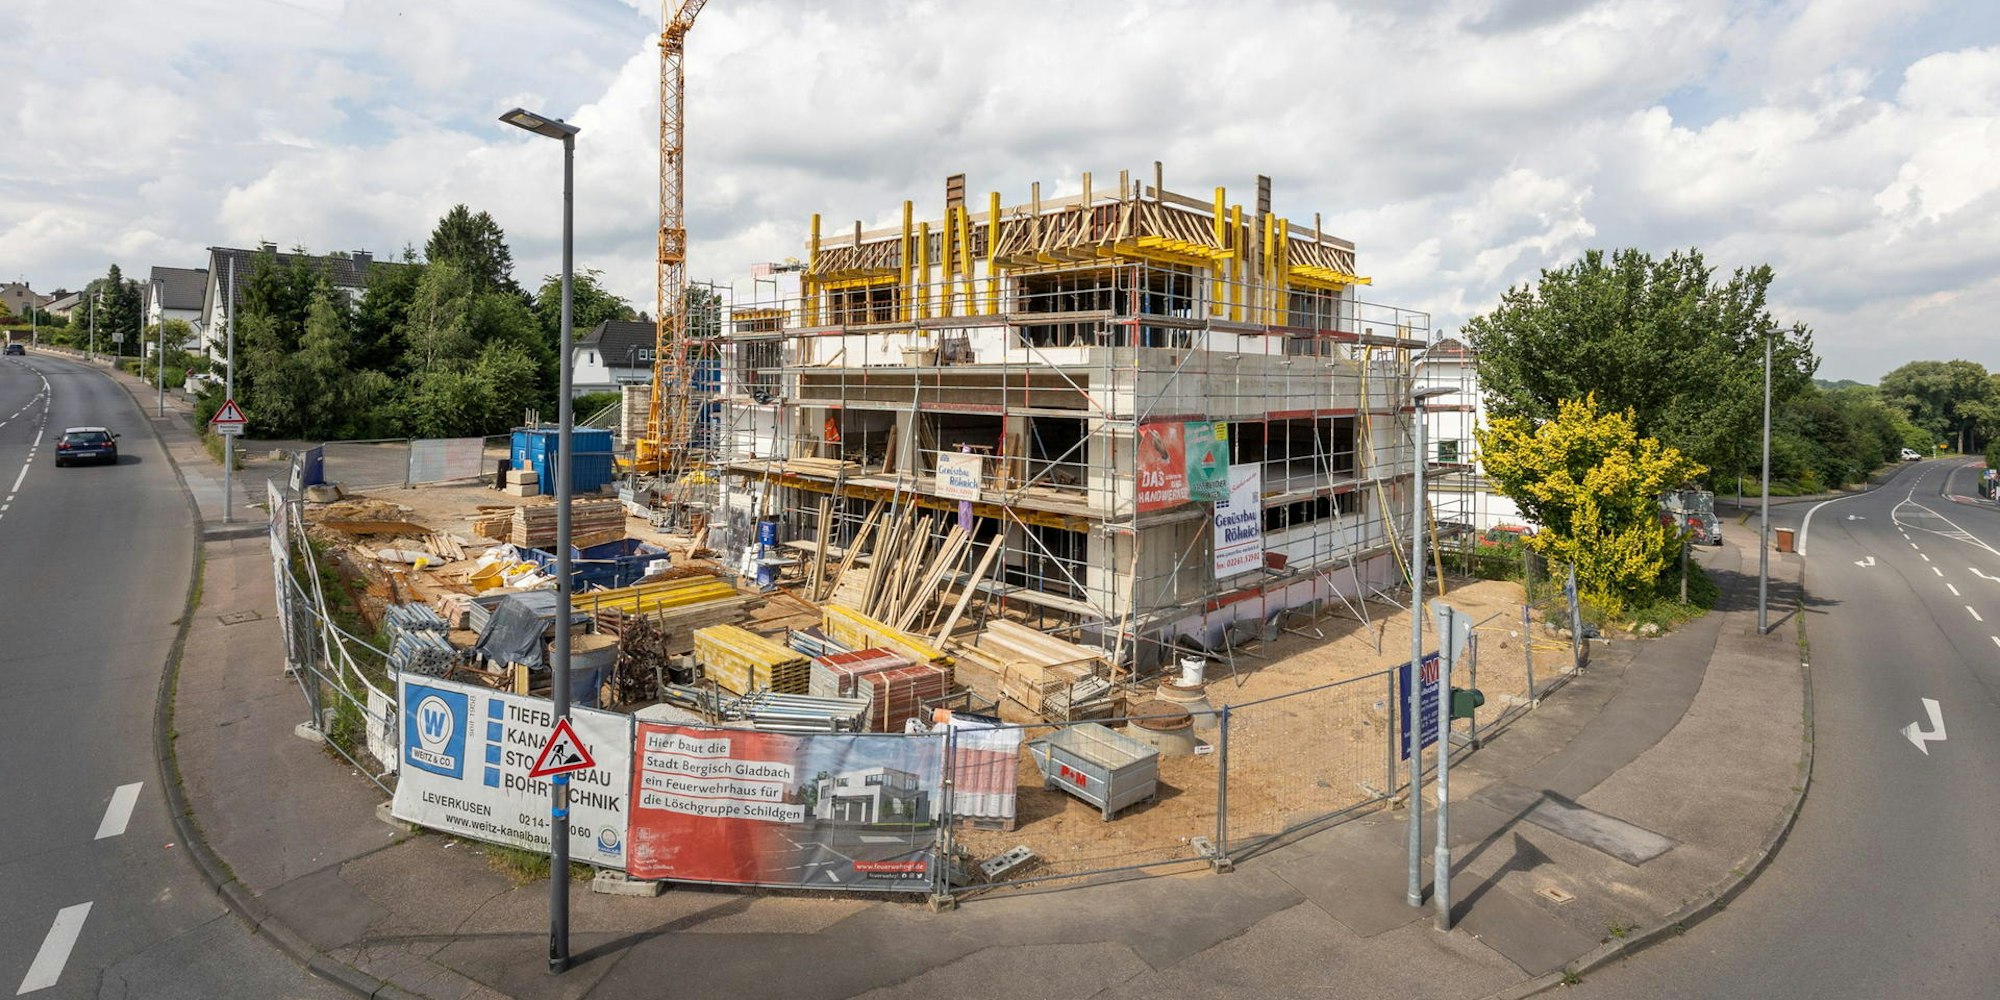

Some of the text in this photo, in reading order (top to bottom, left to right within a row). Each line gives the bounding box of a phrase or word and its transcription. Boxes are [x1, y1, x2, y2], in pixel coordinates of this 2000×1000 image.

[1141, 470, 1165, 488] DAS
[424, 709, 446, 737] W
[413, 749, 432, 763] WEITZ
[433, 756, 439, 764] &
[649, 737, 727, 754] Hier baut die
[647, 756, 790, 779] Stadt Bergisch Gladbach
[645, 776, 779, 798] ein Feuerwehrhaus für
[422, 789, 491, 817] LEVERKUSEN
[643, 793, 800, 821] die Löschgruppe Schildgen
